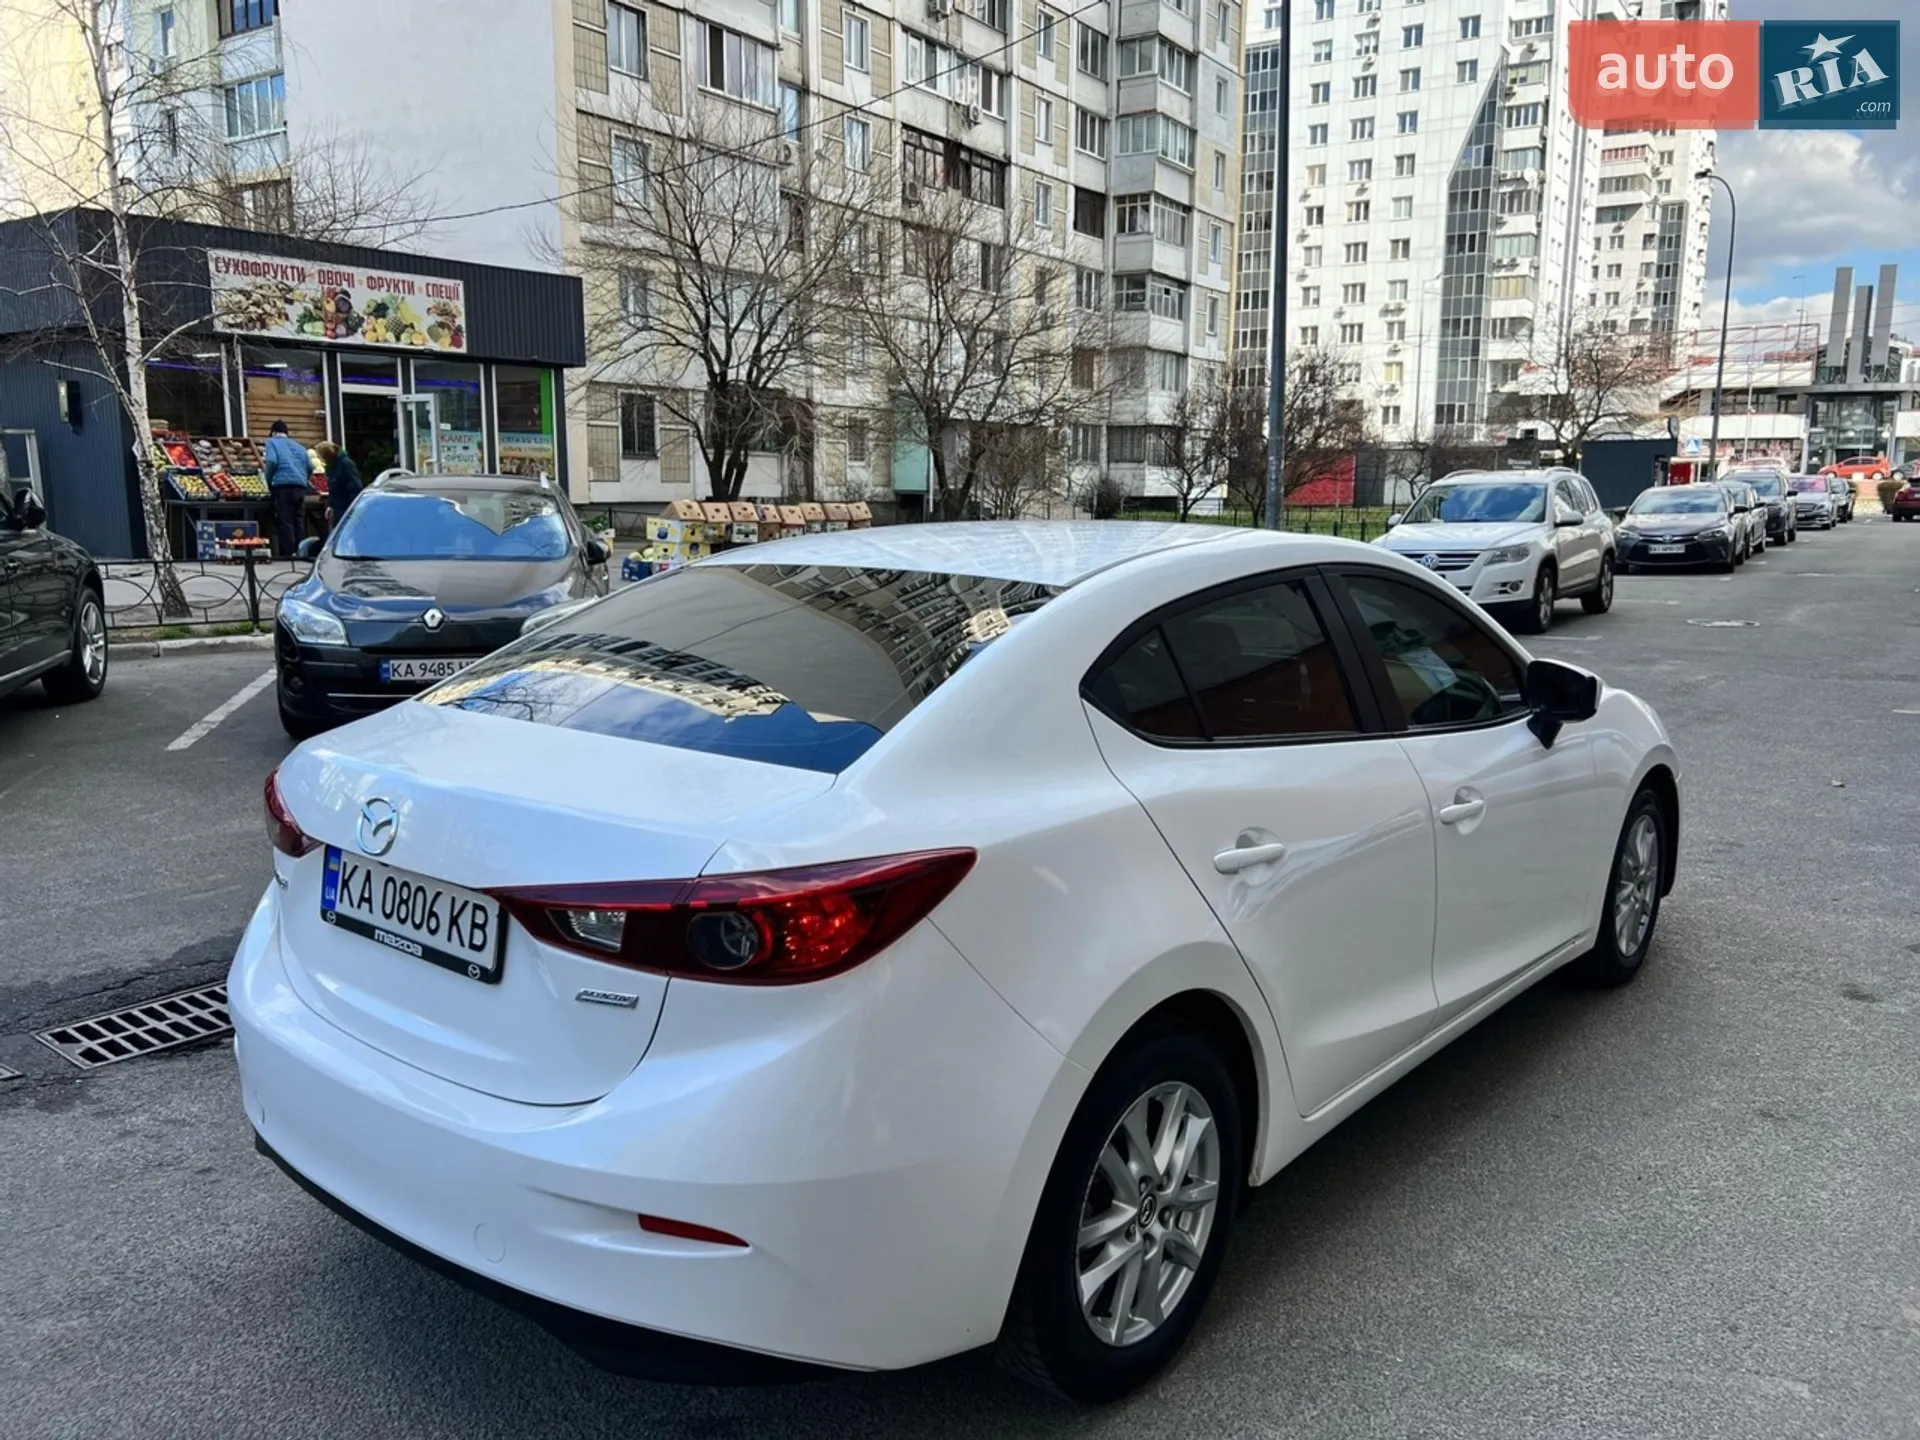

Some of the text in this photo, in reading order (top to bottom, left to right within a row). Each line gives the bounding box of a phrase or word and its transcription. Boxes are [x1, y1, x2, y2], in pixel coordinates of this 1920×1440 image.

[214, 256, 461, 301] СУХОФРУКТИ ОВОЧІ ФРУКТИ СПЕЦІЇ
[391, 663, 415, 678] KA
[418, 662, 455, 677] 9485
[339, 861, 489, 953] KA 0806 KB
[374, 929, 423, 957] mazda
